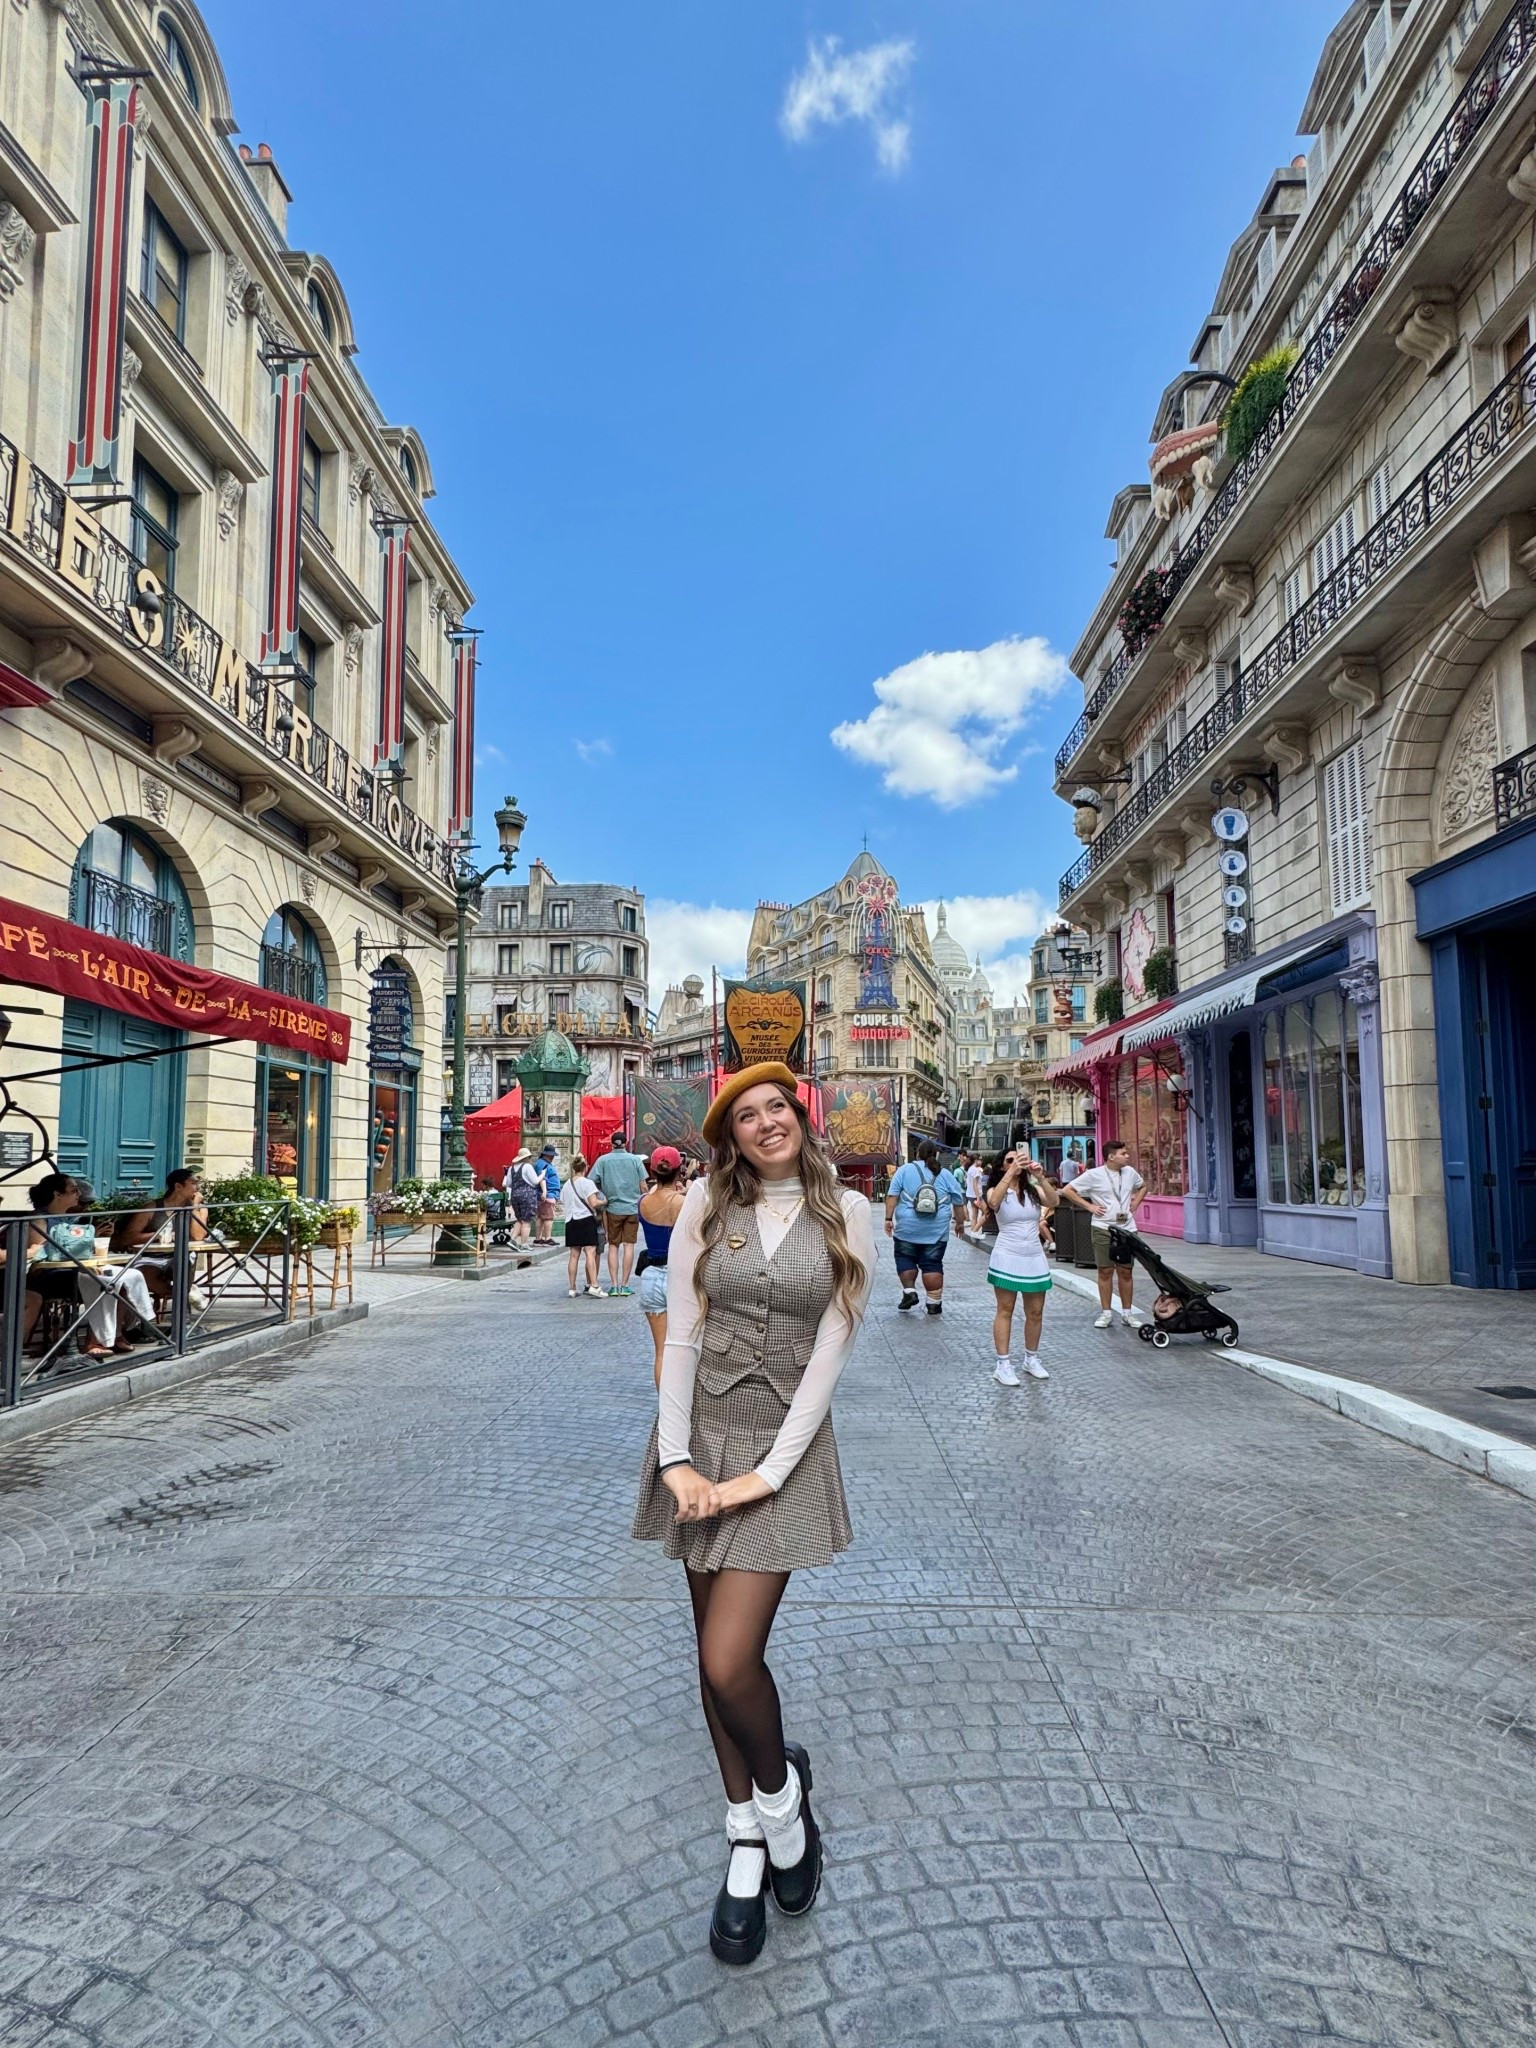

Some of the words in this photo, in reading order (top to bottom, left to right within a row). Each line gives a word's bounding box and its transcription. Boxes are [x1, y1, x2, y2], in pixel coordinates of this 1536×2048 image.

[212, 640, 460, 892] MIRIFIQUES
[0, 920, 50, 961] FÉ
[80, 948, 150, 1000] L'AIR
[174, 985, 206, 1014] DE
[226, 996, 252, 1022] LA
[268, 1006, 328, 1042] SIRÈNE
[331, 1030, 344, 1046] 32
[749, 996, 793, 1005] CIRQUE
[729, 1006, 802, 1017] ARCANUS
[501, 1011, 544, 1037] CRI
[853, 1013, 889, 1027] COUPE
[891, 1013, 906, 1026] DE
[849, 1027, 911, 1041] QUIDDITCH
